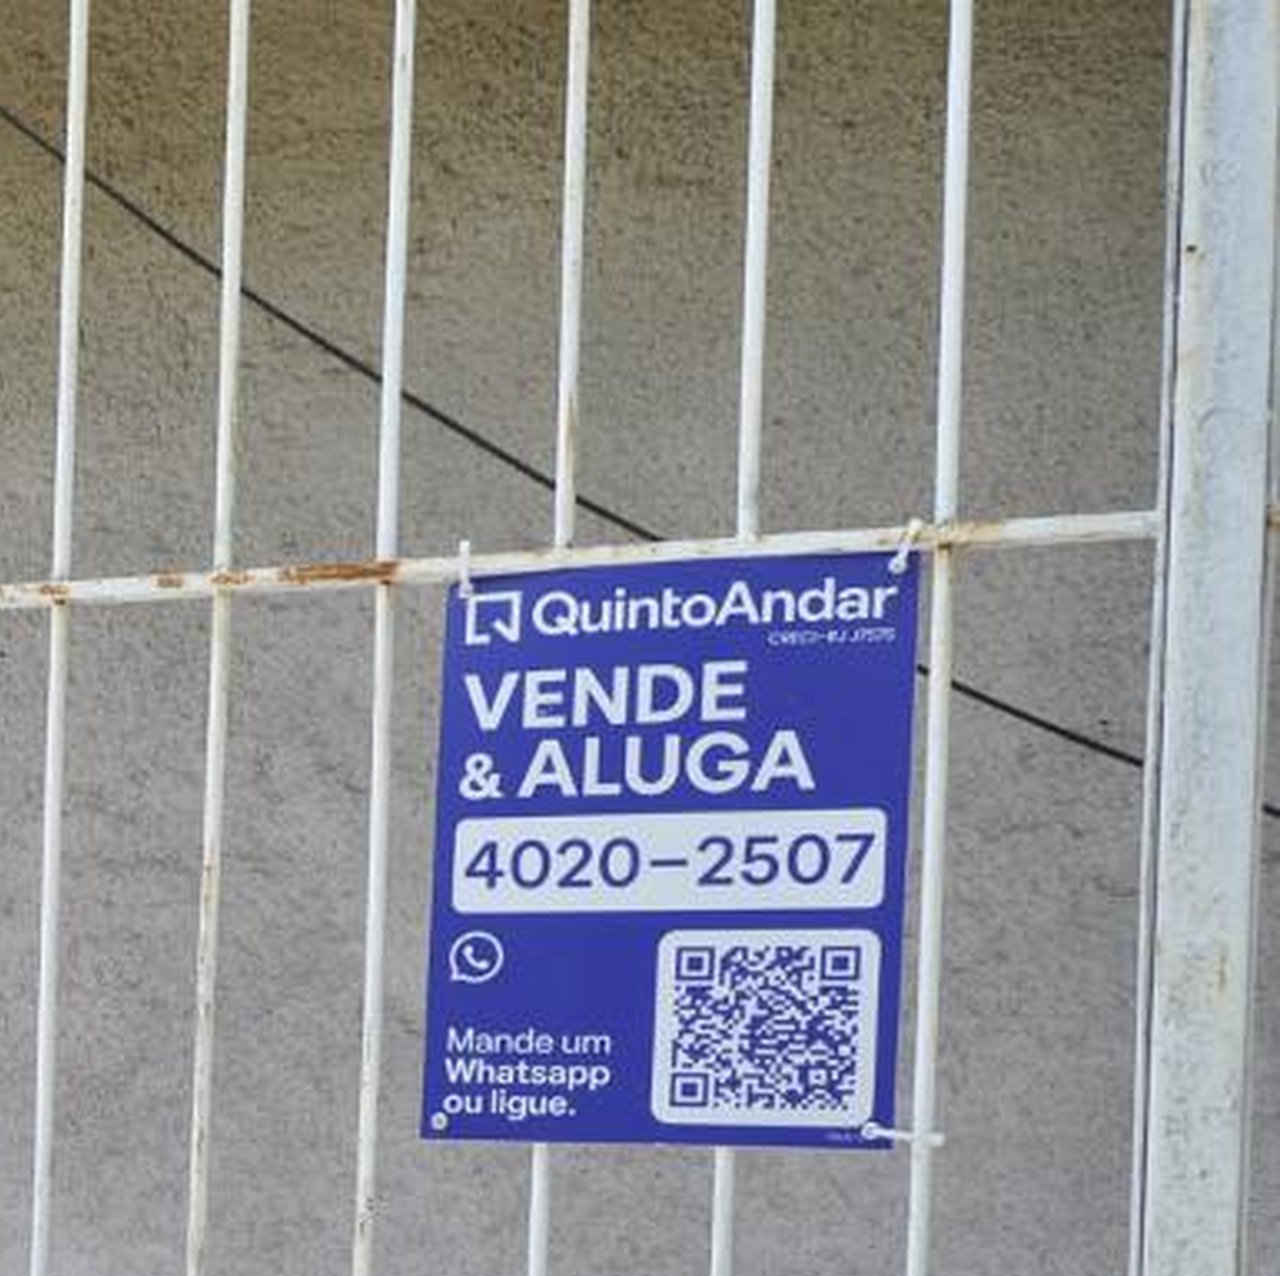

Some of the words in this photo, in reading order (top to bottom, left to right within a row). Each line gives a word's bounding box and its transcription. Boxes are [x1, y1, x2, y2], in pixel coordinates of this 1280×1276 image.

[532, 577, 898, 635] QuintoAndar
[464, 660, 749, 731] VENDE
[458, 753, 502, 799] &
[517, 730, 816, 798] ALUGA
[464, 832, 876, 889] 4020-2507
[447, 1025, 554, 1054] Mande
[561, 1034, 611, 1055] um
[444, 1057, 611, 1091] Whatsapp
[442, 1094, 483, 1115] ou
[490, 1088, 576, 1121] ligue.
